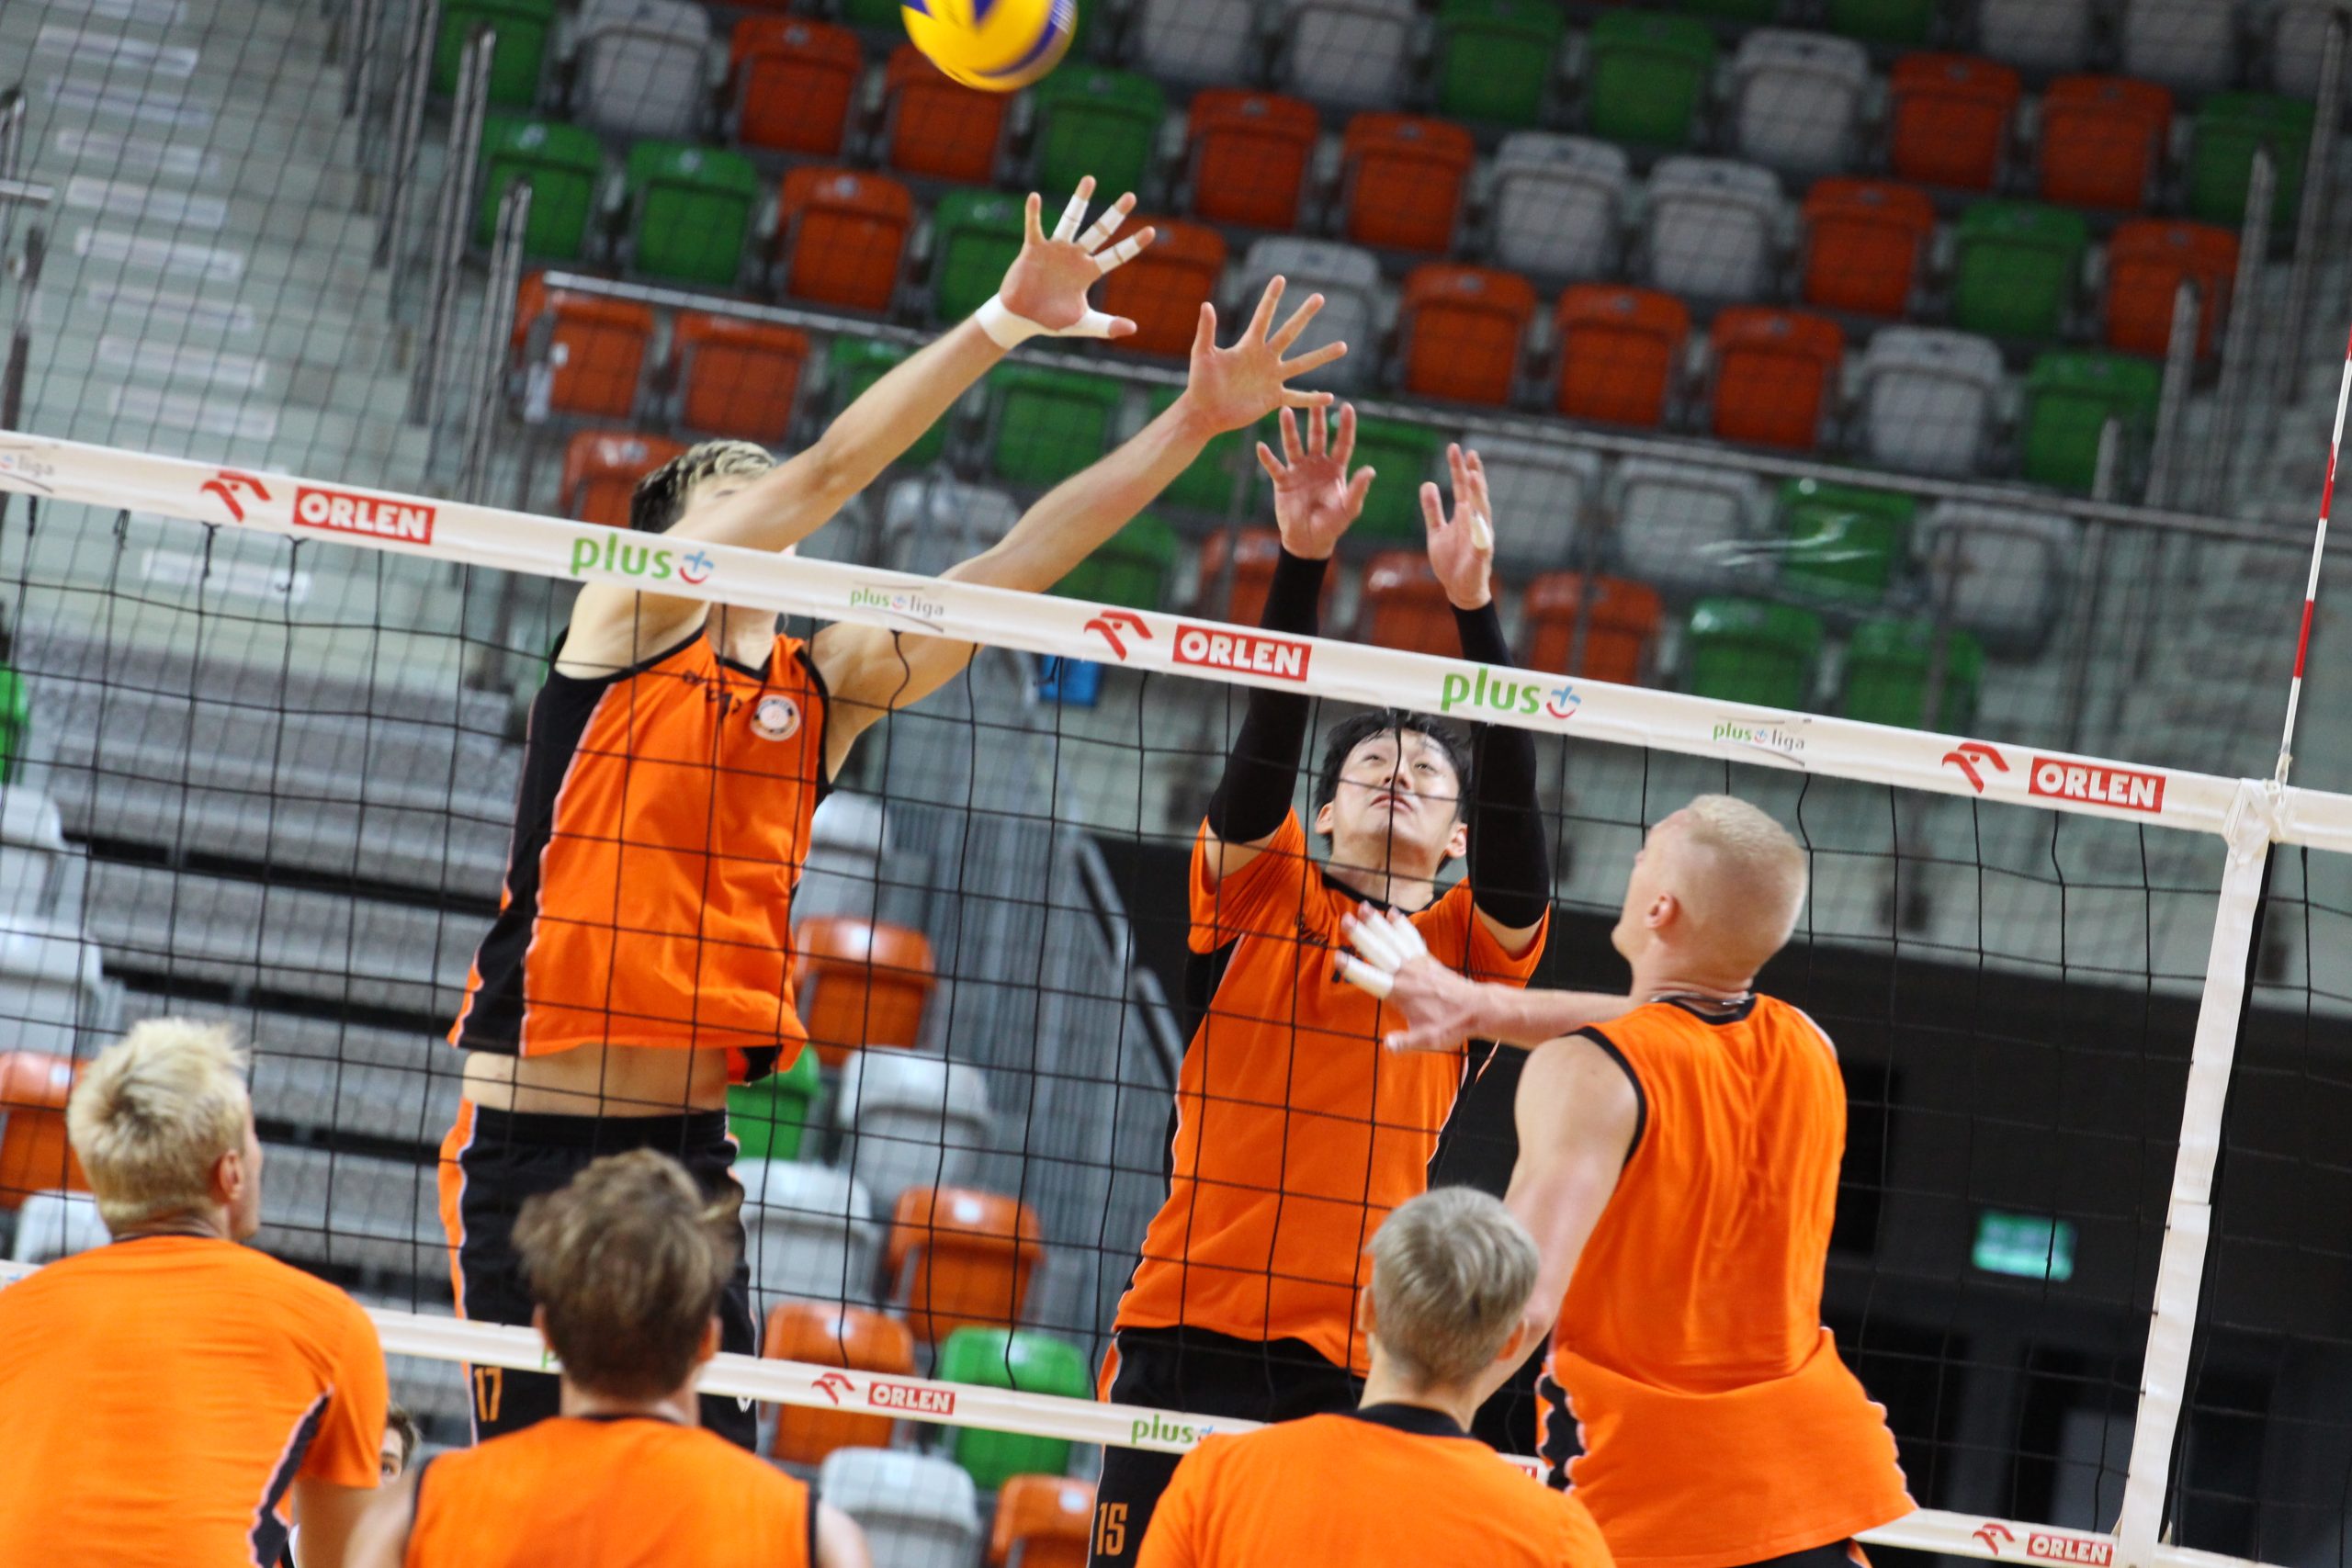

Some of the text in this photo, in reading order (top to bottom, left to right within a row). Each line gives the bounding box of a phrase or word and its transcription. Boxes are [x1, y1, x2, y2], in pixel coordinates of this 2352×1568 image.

[299, 492, 429, 540] ORLEN
[571, 532, 673, 579] plus
[850, 588, 944, 617] plus liga
[1180, 636, 1305, 677] ORLEN
[1441, 667, 1541, 714] plus
[1713, 722, 1805, 750] plus liga
[2036, 761, 2158, 809] ORLEN
[473, 1367, 503, 1422] 17
[872, 1386, 950, 1414] ORLEN
[1131, 1413, 1193, 1445] plus
[1096, 1502, 1128, 1556] 15
[2031, 1535, 2109, 1563] ORLEN
